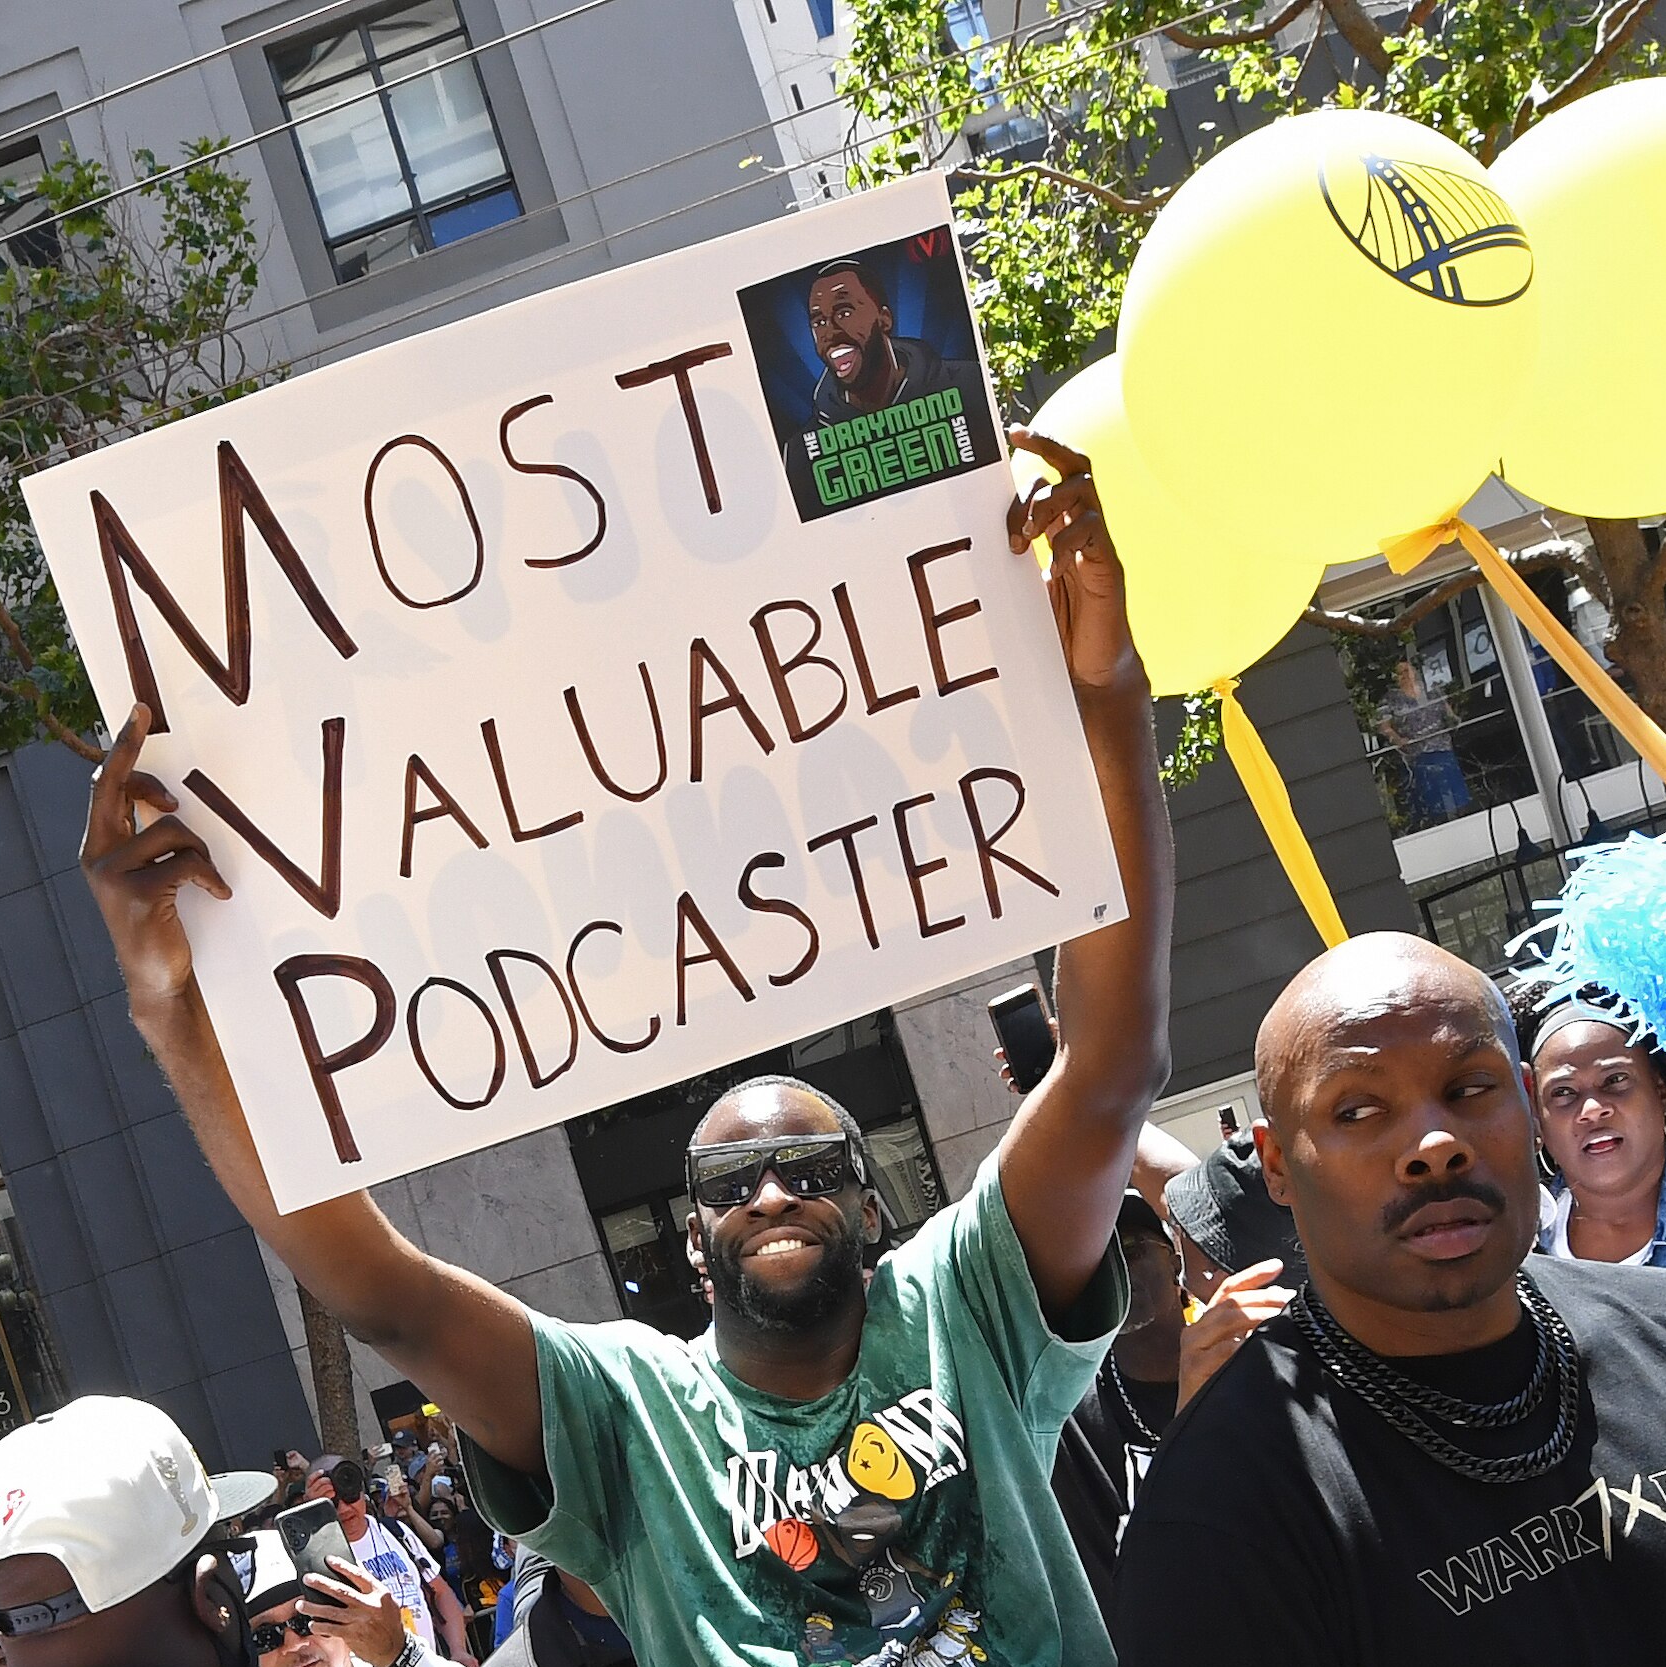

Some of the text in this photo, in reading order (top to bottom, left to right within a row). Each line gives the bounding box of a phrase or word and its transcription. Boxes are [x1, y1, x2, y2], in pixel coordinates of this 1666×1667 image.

[803, 431, 822, 460] THE
[817, 387, 964, 454] DRAYMOND
[950, 415, 976, 463] SHOW
[812, 422, 961, 506] GREEN
[91, 343, 732, 736] MOST
[183, 537, 999, 919] VALUABLE
[274, 767, 1059, 1164] PODCASTER
